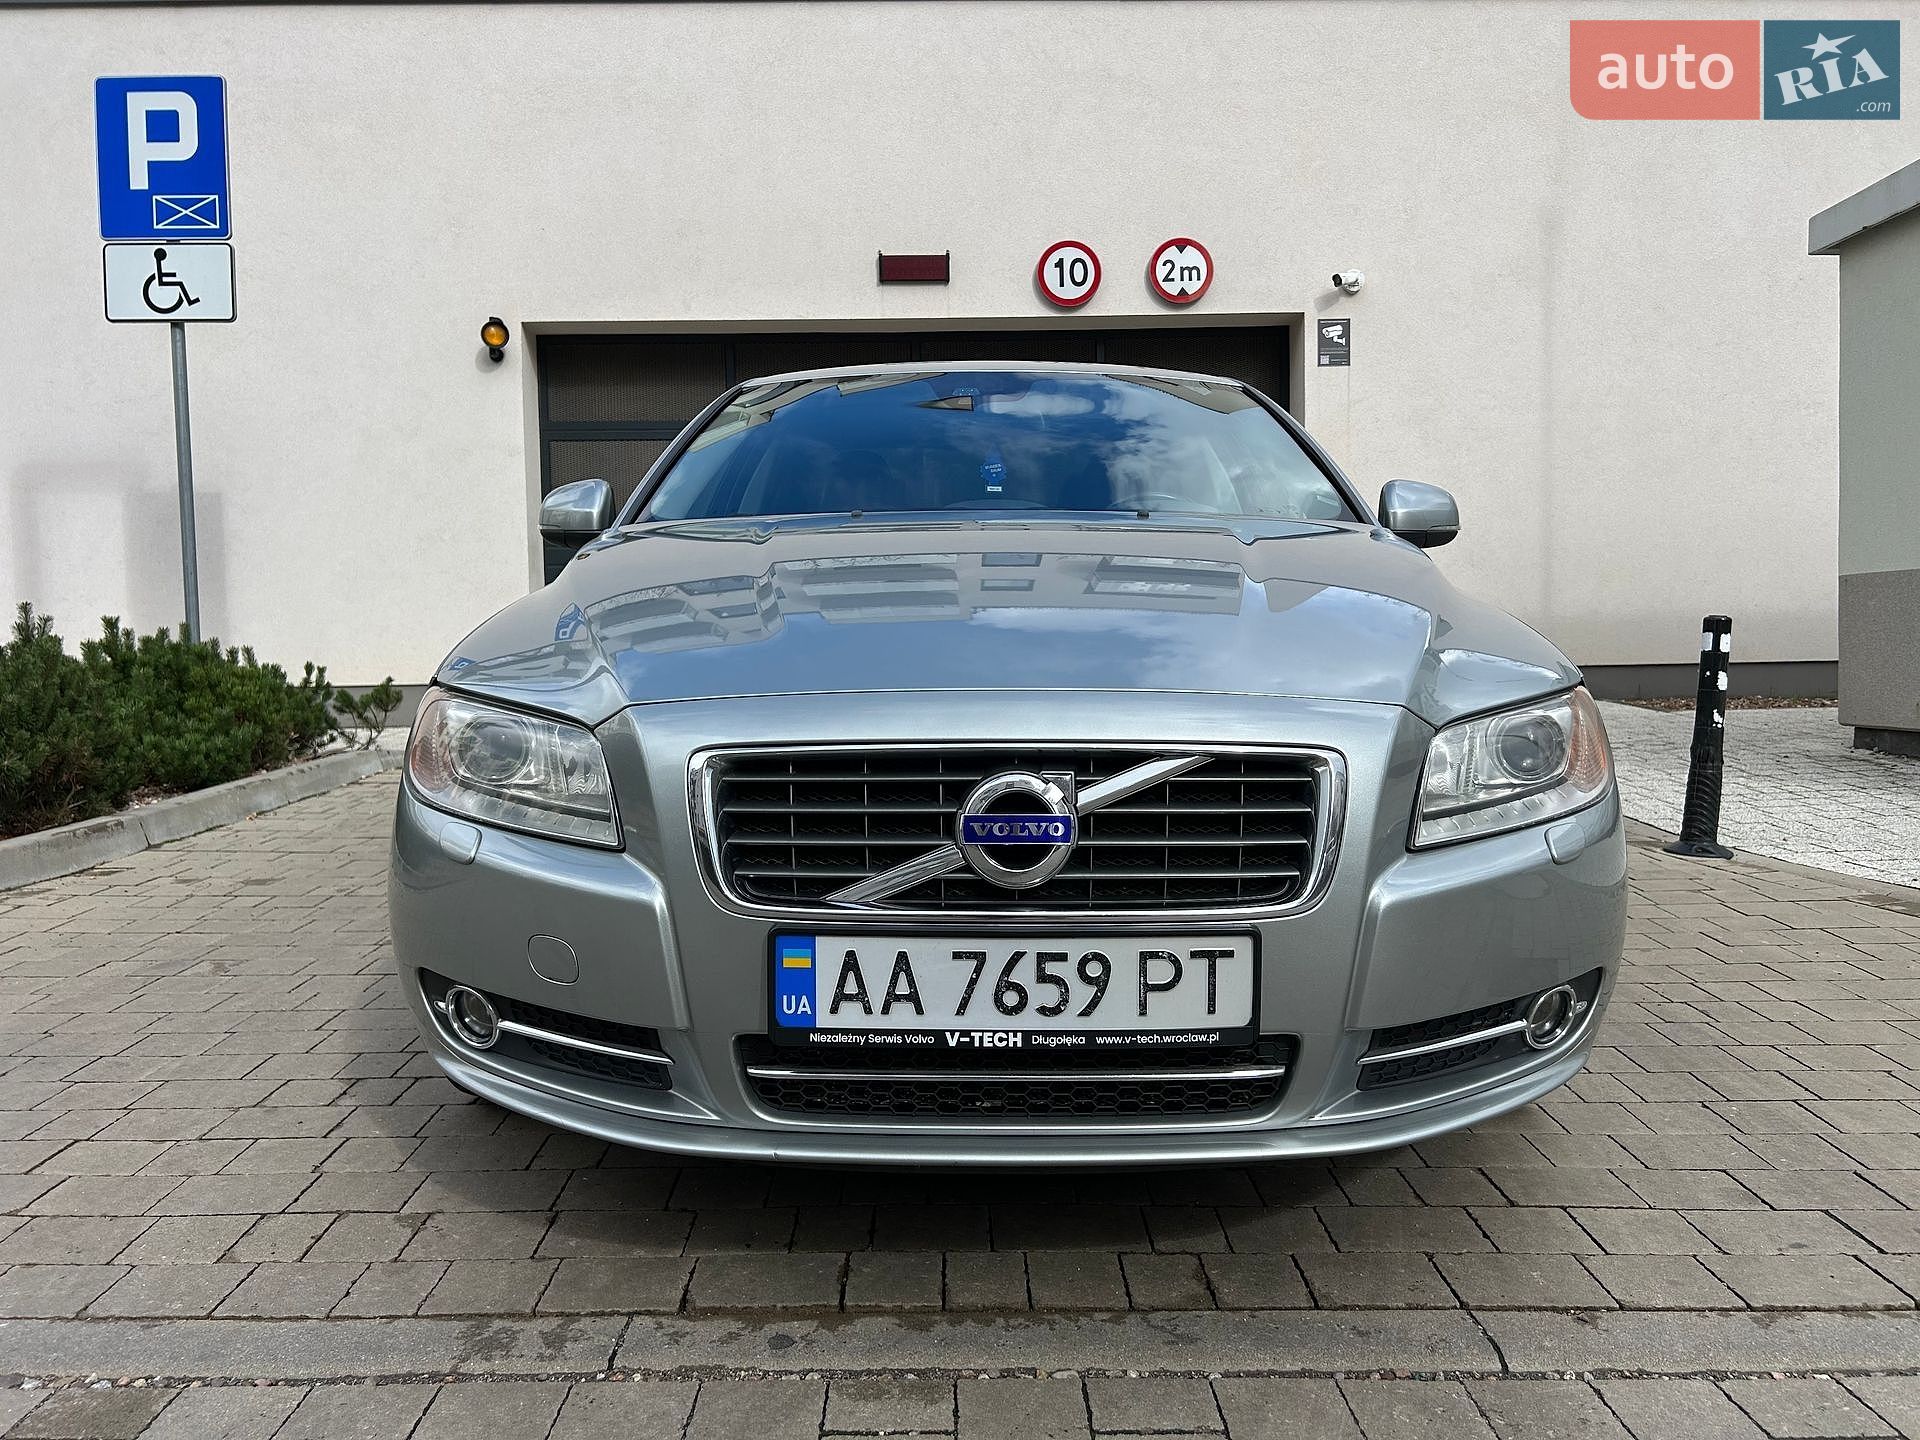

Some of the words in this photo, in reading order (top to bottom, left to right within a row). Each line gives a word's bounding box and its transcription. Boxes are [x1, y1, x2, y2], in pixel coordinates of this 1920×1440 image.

[126, 91, 199, 190] P
[1054, 257, 1089, 288] 10
[969, 822, 1065, 837] VOLVO
[828, 949, 925, 1016] AA
[951, 950, 1112, 1018] 7659
[1136, 948, 1235, 1017] PT
[782, 994, 812, 1015] UA
[809, 1033, 866, 1046] Niezależny
[868, 1033, 903, 1044] Serwis
[904, 1034, 935, 1044] Volvo
[945, 1031, 1022, 1048] V-TECH
[1031, 1034, 1086, 1047] Długołęka
[1095, 1031, 1220, 1044] www.v-tech.wroclaw.pl
